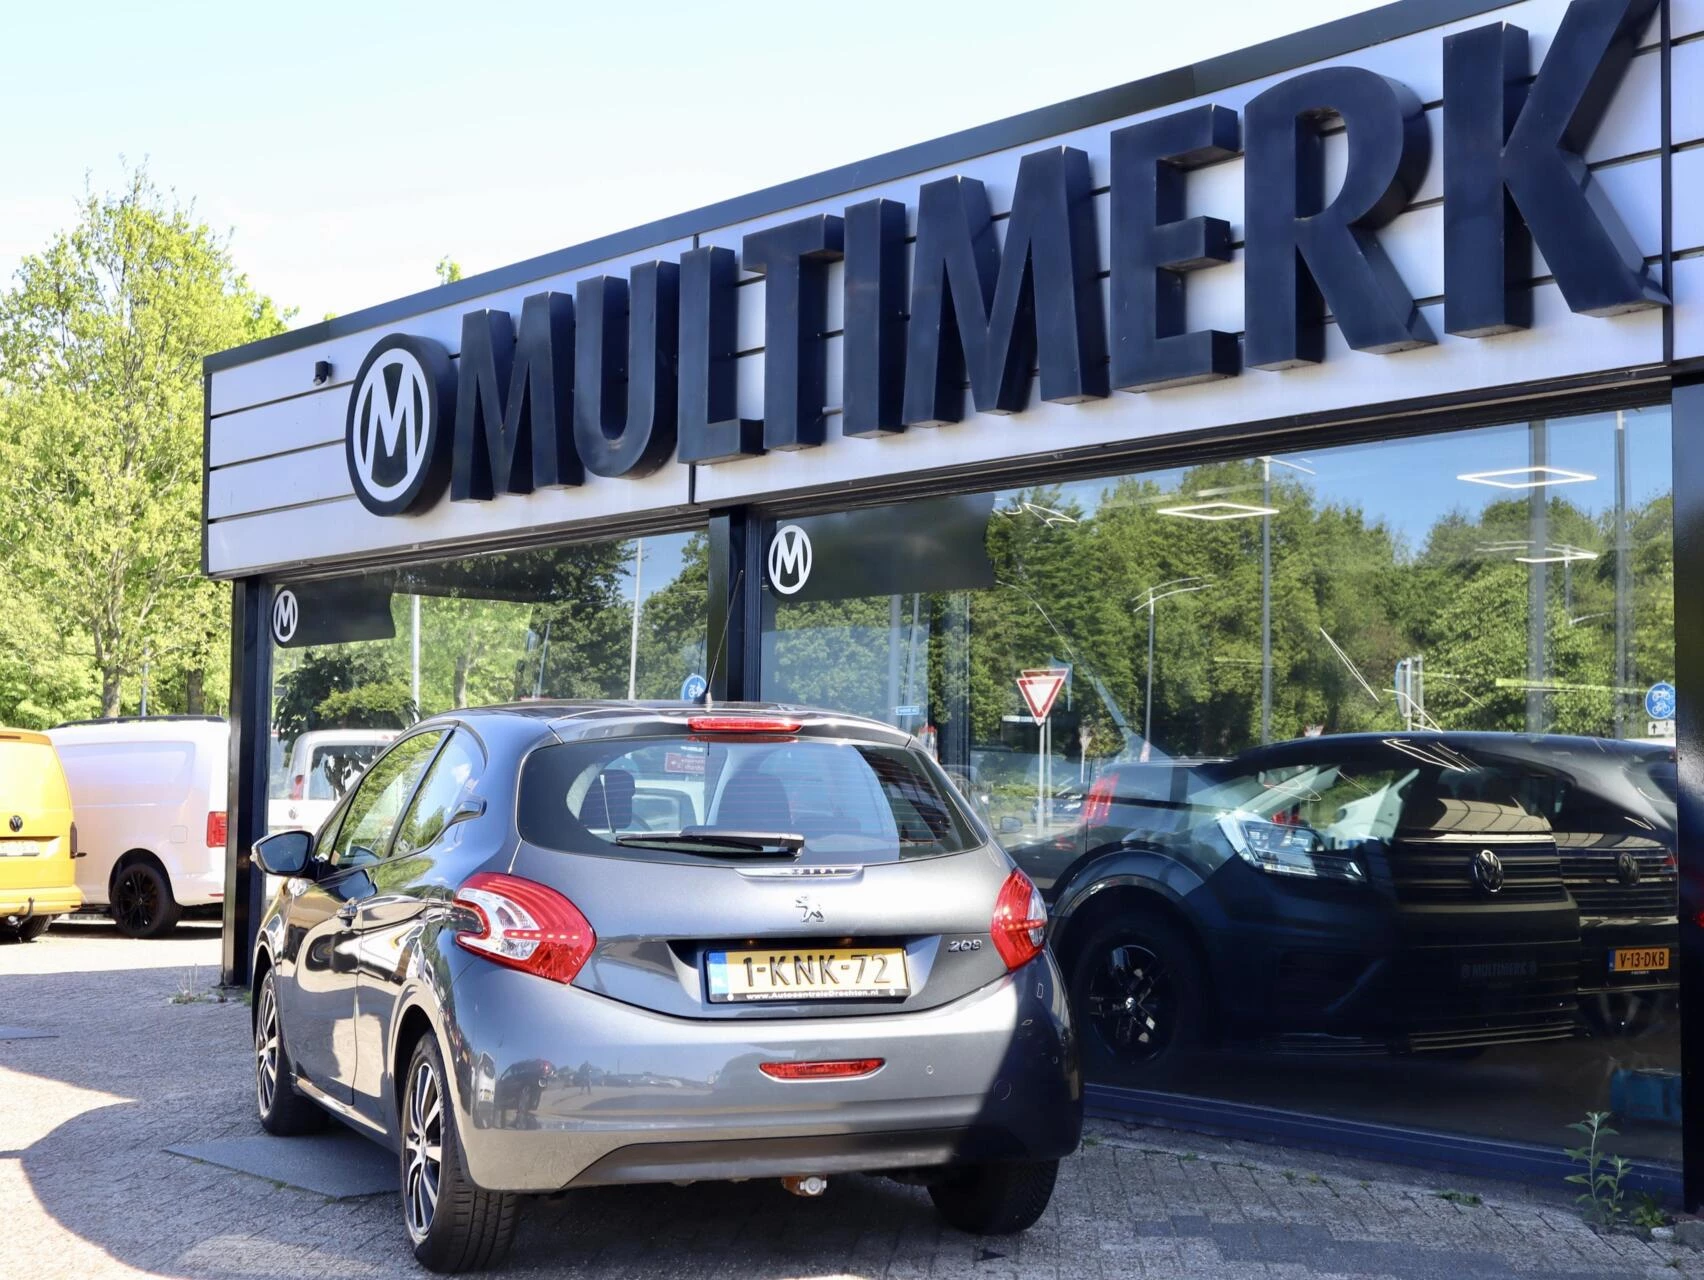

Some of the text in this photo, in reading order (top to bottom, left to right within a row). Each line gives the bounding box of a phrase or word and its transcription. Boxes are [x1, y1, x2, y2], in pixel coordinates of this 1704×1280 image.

[451, 0, 1669, 502] MULTIMERK
[948, 939, 982, 952] 208
[743, 953, 893, 987] 1-KNK-72
[1620, 952, 1665, 968] V-13-DKB
